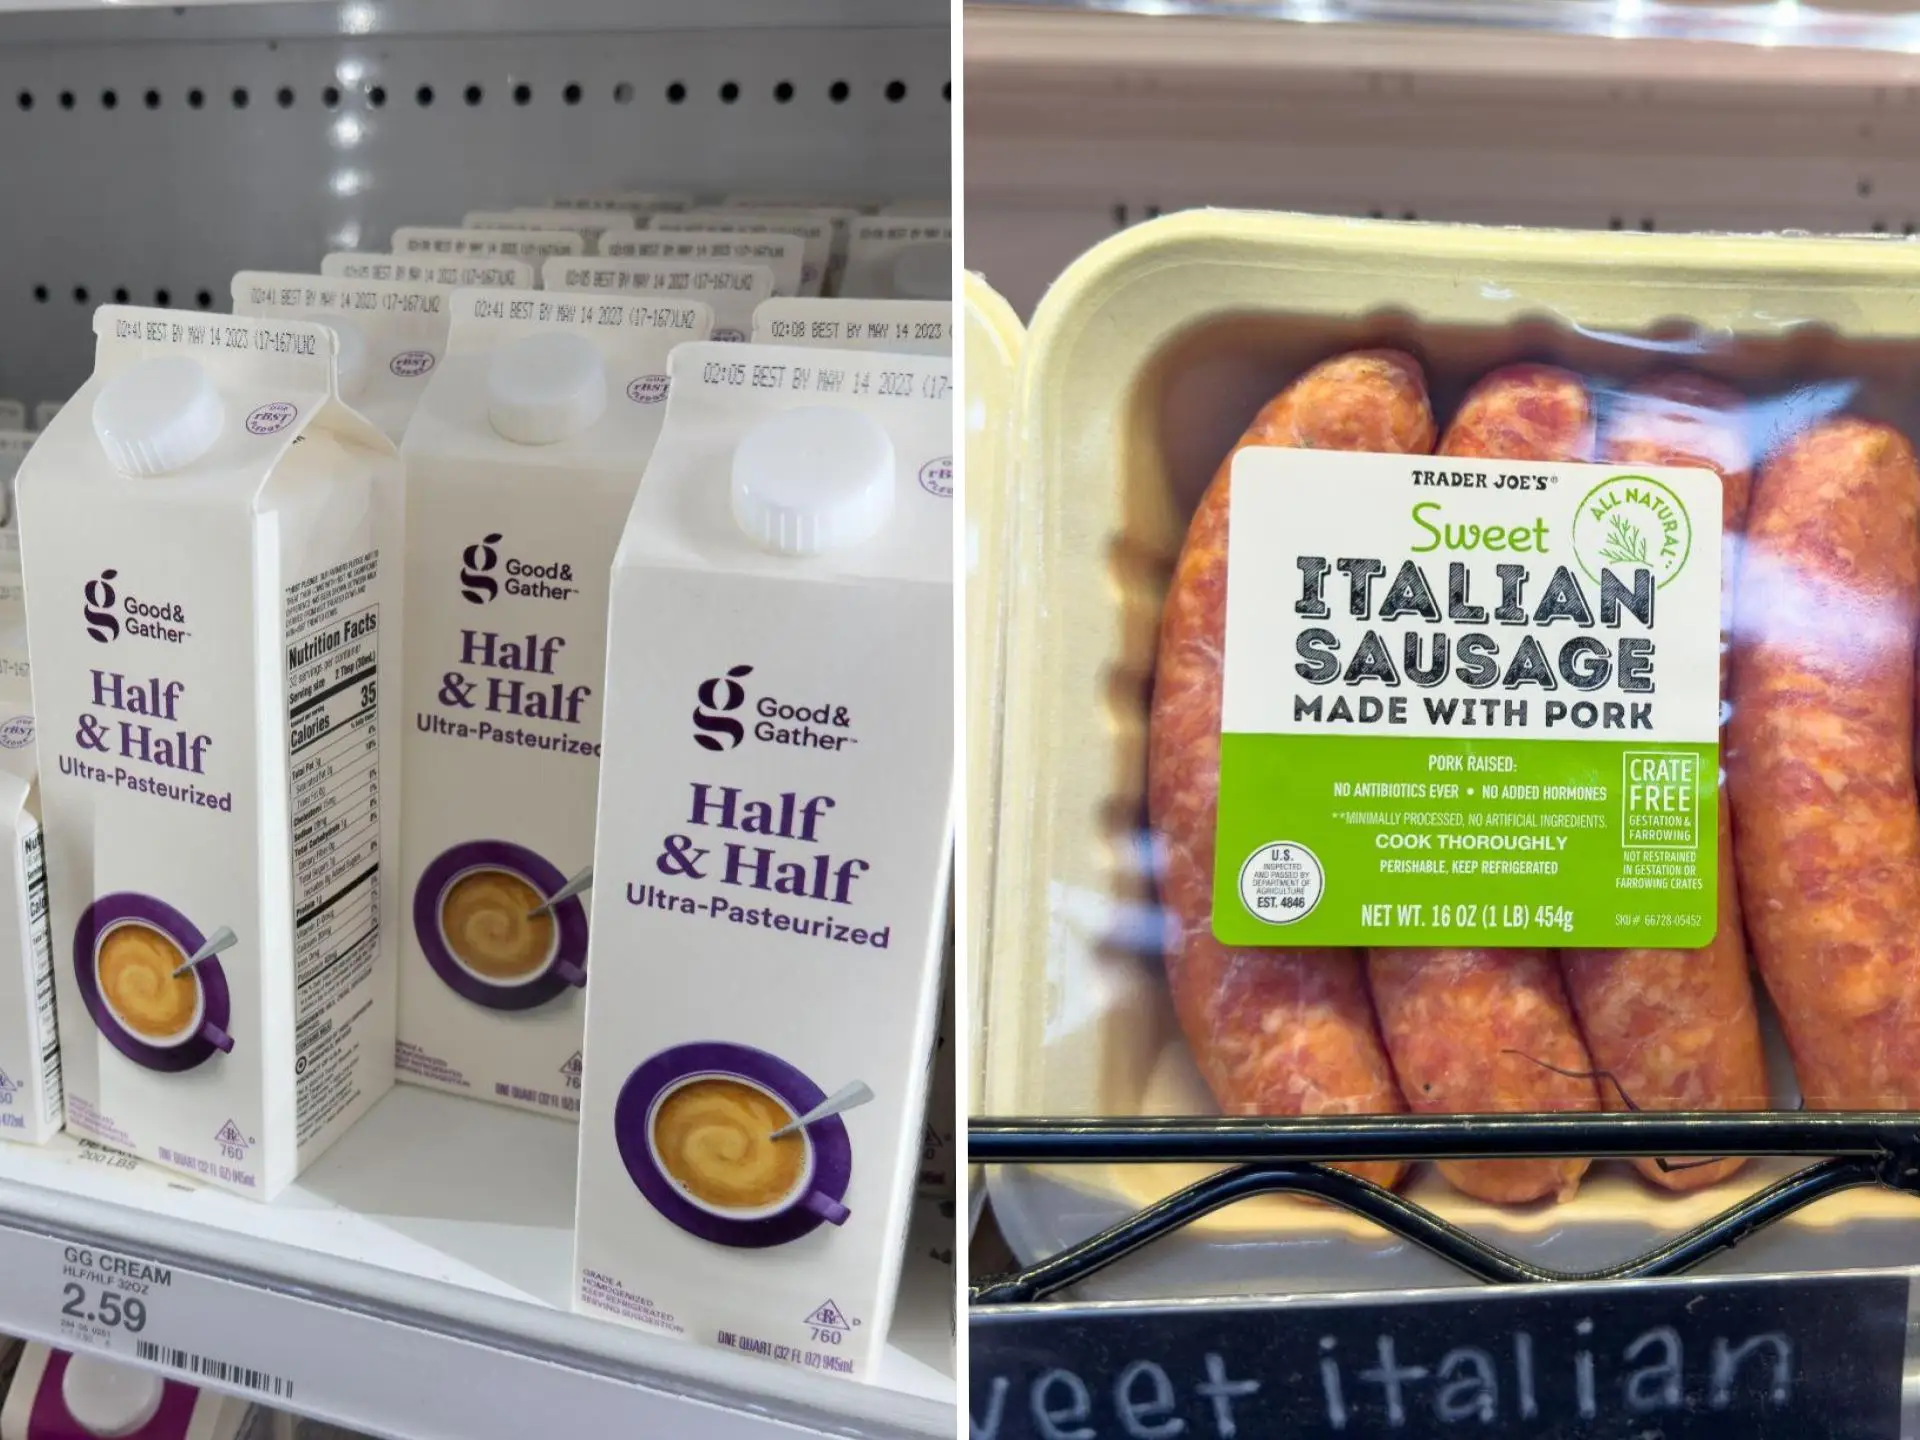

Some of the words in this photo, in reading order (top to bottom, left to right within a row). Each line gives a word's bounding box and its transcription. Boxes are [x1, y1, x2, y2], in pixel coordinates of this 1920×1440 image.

[474, 300, 503, 319] 02:41
[510, 302, 534, 319] BEST
[539, 302, 552, 322] BY
[581, 306, 592, 324] 14
[598, 306, 623, 325] 2023
[116, 320, 141, 339] 02:41
[147, 322, 167, 342] BEST
[172, 324, 183, 343] BY
[210, 327, 221, 346] 14
[226, 327, 249, 349] 2023
[812, 322, 840, 339] BEST
[847, 323, 861, 339] BY
[868, 323, 889, 339] MAY
[895, 323, 908, 339] 14
[914, 324, 942, 340] 2023
[703, 362, 746, 385] 02:05
[752, 365, 786, 388] BEST
[792, 367, 811, 390] BY
[816, 368, 845, 392] MAY
[853, 371, 871, 394] 14
[878, 372, 914, 396] 2023
[1412, 470, 1487, 488] TRADER
[1590, 491, 1622, 522] ALL
[1411, 502, 1550, 553] Sweet
[1294, 556, 1655, 629] ITALIAN
[289, 630, 340, 671] Nutrition
[344, 612, 377, 642] Facts
[459, 629, 566, 675] Half
[1294, 628, 1655, 694] SAUSAGE
[90, 668, 185, 721] Half
[361, 681, 377, 708] 35
[438, 672, 478, 709] &
[485, 677, 592, 724] Half
[1294, 694, 1407, 725] MADE
[1423, 696, 1528, 727] WITH
[1545, 701, 1654, 731] PORK
[75, 713, 110, 754] &
[118, 720, 213, 775] Half
[291, 715, 330, 749] Calories
[1428, 754, 1464, 772] PORK
[1467, 755, 1517, 773] RAISED:
[1630, 759, 1692, 783] CRATE
[58, 754, 232, 813] Ultra-Pasteurized
[1333, 782, 1351, 797] NO
[1354, 782, 1426, 799] ANTIBIOTICS
[1429, 784, 1460, 799] EVER
[1482, 785, 1499, 800] NO
[1501, 785, 1540, 800] ADDED
[1543, 786, 1608, 801] HORMONES
[686, 782, 836, 843] Half
[1630, 785, 1691, 813] FREE
[1403, 812, 1466, 828] PROCESSED,
[1468, 813, 1483, 827] NO
[1486, 813, 1540, 828] ARTIFICIAL
[1541, 814, 1608, 830] INGREDIENTS.
[1629, 815, 1683, 827] GESTATION
[1684, 816, 1691, 827] &
[1629, 829, 1691, 842] FARROWING
[1271, 849, 1294, 861] U.S.
[1375, 834, 1432, 849] COOK
[1436, 834, 1568, 851] THOROUGHLY
[1623, 850, 1641, 862] NOT
[1643, 851, 1696, 863] RESTRAINED
[656, 833, 710, 880] &
[720, 842, 870, 905] Half
[1380, 858, 1449, 876] PERISHABLE,
[1452, 859, 1479, 874] KEEP
[1481, 860, 1559, 875] REFRIGERATED
[1623, 864, 1632, 875] IN
[1635, 864, 1682, 876] GESTATION
[1684, 865, 1696, 876] OR
[1616, 877, 1669, 889] FARROWING
[1671, 878, 1703, 890] CRATES
[626, 881, 891, 950] Ultra-Pasteurized
[1257, 897, 1278, 909] EST.
[1361, 904, 1393, 927] NET
[1397, 904, 1426, 927] WT.
[1431, 904, 1451, 928] 16
[1455, 904, 1477, 928] OZ
[1481, 904, 1498, 930] (1
[1503, 904, 1530, 930] LB)
[1534, 905, 1574, 933] 454g
[220, 1143, 244, 1161] 760
[63, 1264, 115, 1285] HLF/HLF
[117, 1278, 150, 1296] 32OZ
[64, 1246, 93, 1267] GG
[99, 1254, 172, 1287] CREAM
[61, 1282, 147, 1333] 2.59
[717, 1329, 737, 1347] ONE
[738, 1335, 772, 1357] QUART
[773, 1344, 790, 1361] (32
[791, 1348, 802, 1364] FL
[810, 1326, 842, 1345] 760
[1318, 1316, 1791, 1431] italian
